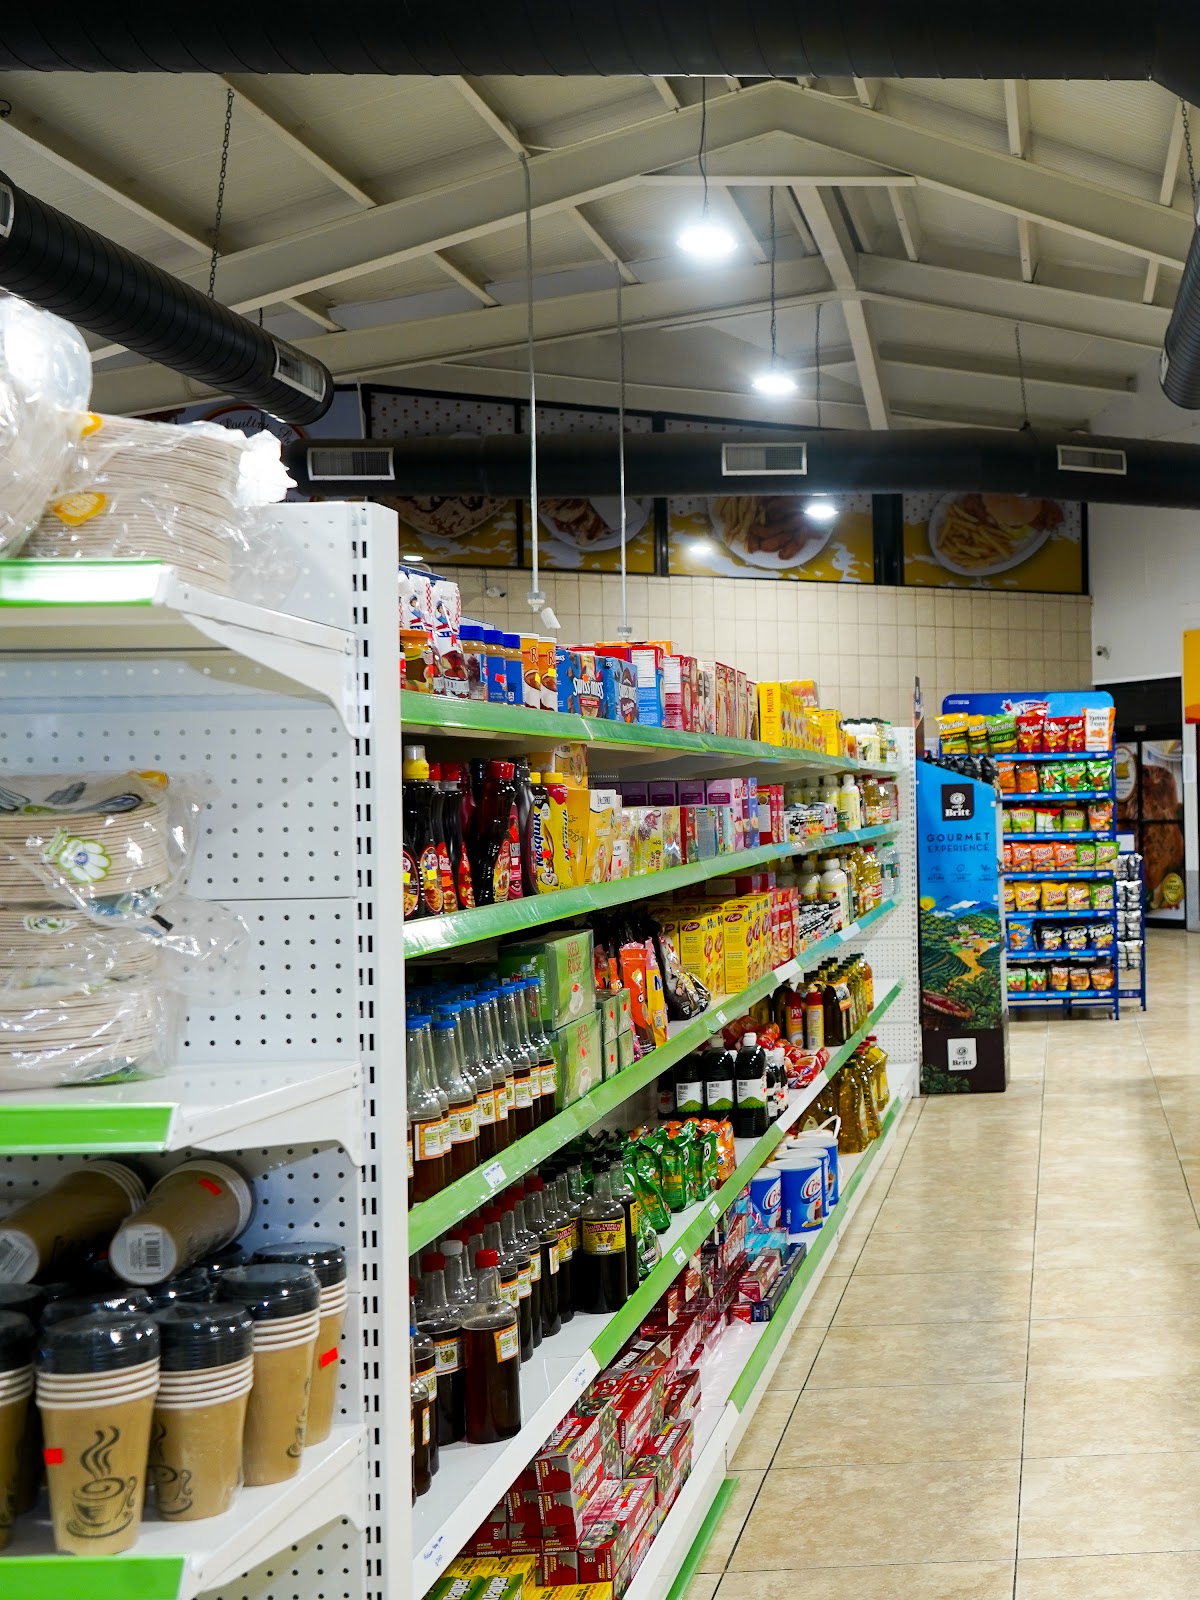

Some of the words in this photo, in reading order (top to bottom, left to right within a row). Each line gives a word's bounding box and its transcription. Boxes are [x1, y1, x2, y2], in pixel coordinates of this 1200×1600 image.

[945, 808, 971, 817] Britt
[534, 812, 544, 867] Nesquik
[926, 832, 990, 843] GOURMET
[927, 844, 989, 853] EXPERIENCE
[952, 1059, 973, 1067] Britt
